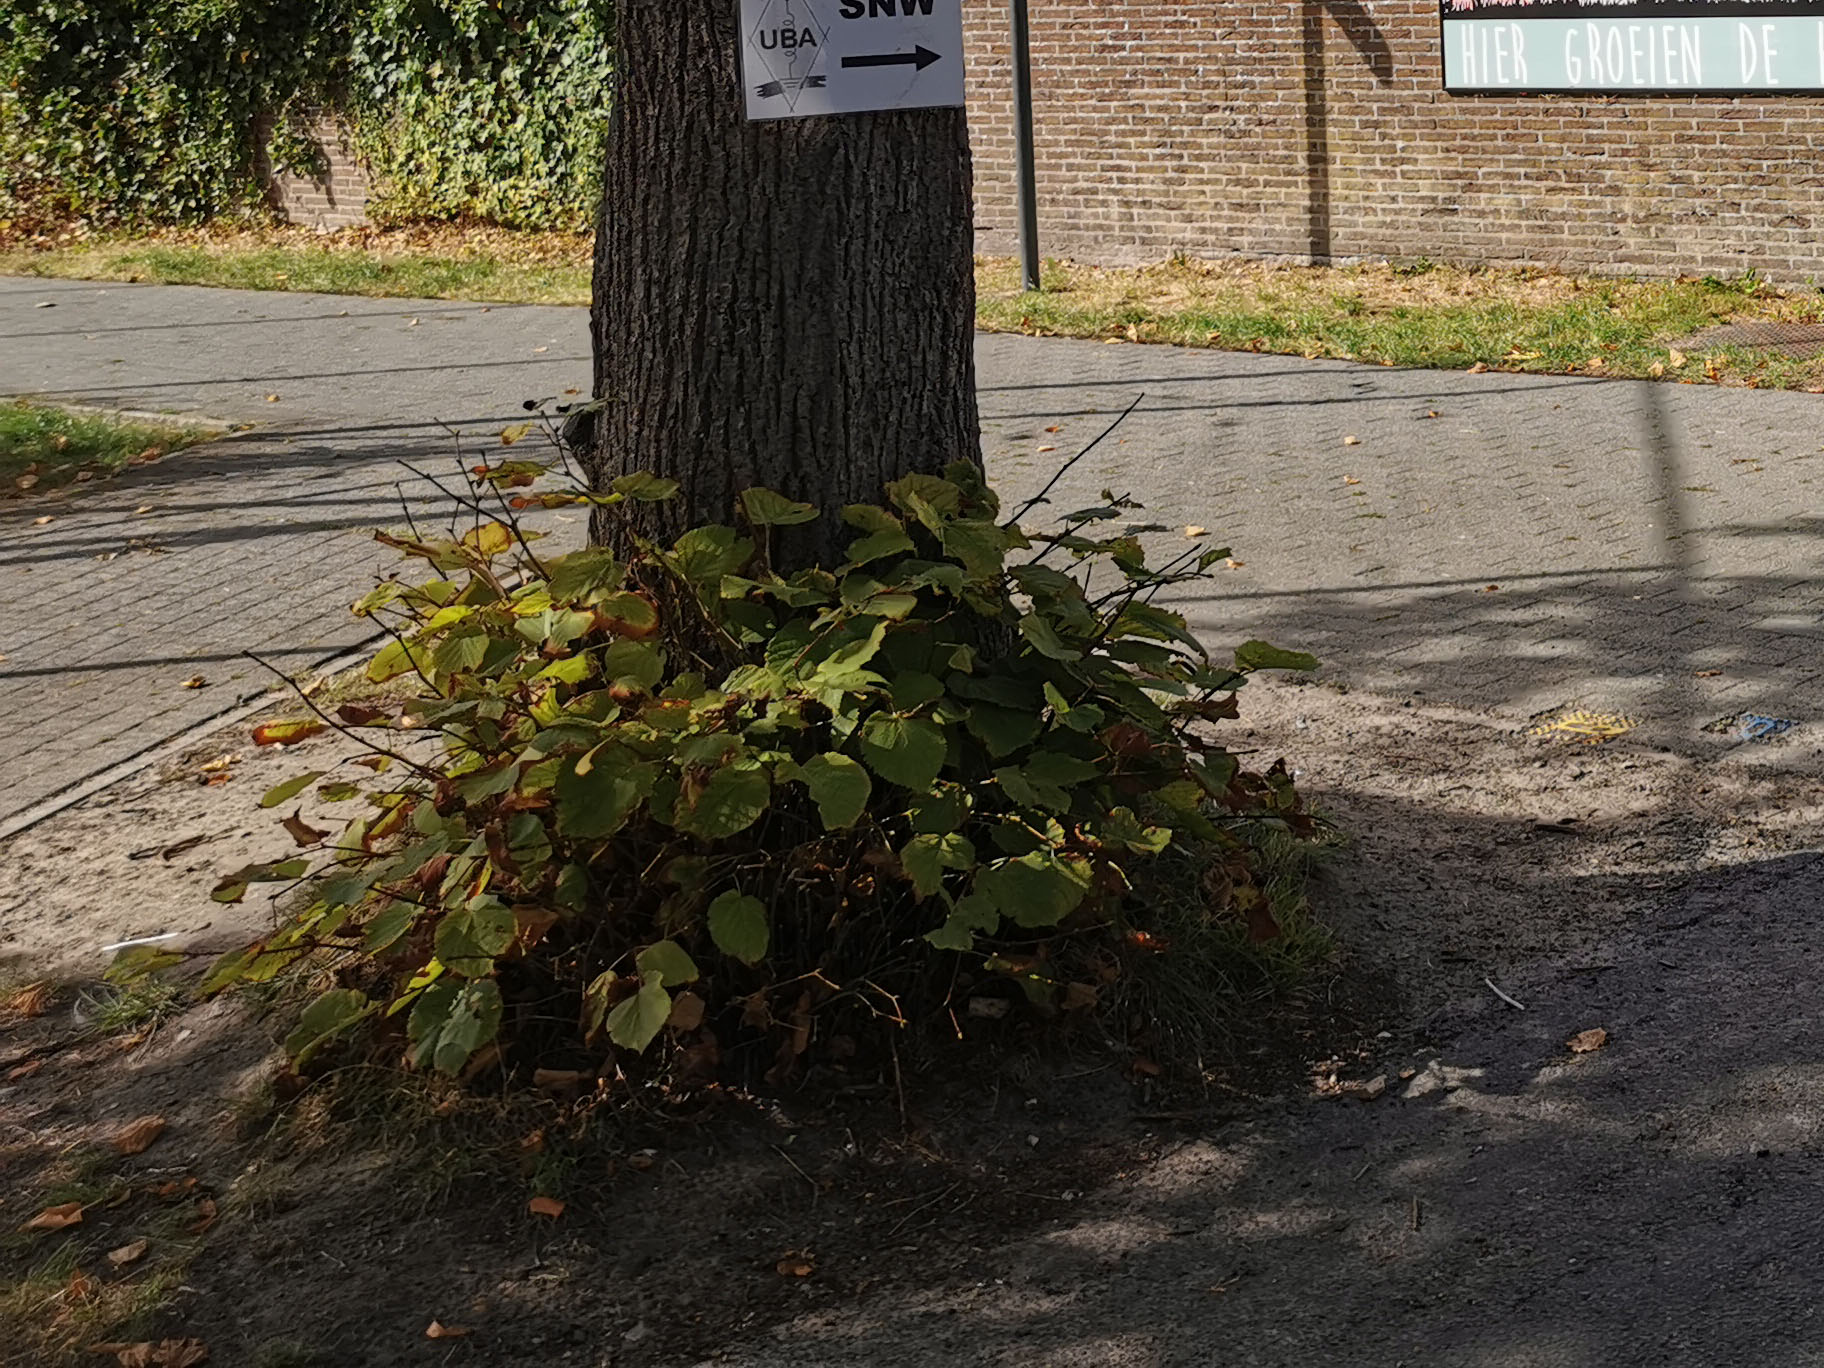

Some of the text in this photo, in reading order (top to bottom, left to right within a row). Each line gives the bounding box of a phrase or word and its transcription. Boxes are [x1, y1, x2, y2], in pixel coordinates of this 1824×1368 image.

[759, 27, 818, 50] UBA
[1460, 22, 1528, 85] HIER
[1565, 21, 1701, 86] GROEIEN
[1738, 22, 1779, 85] DE
